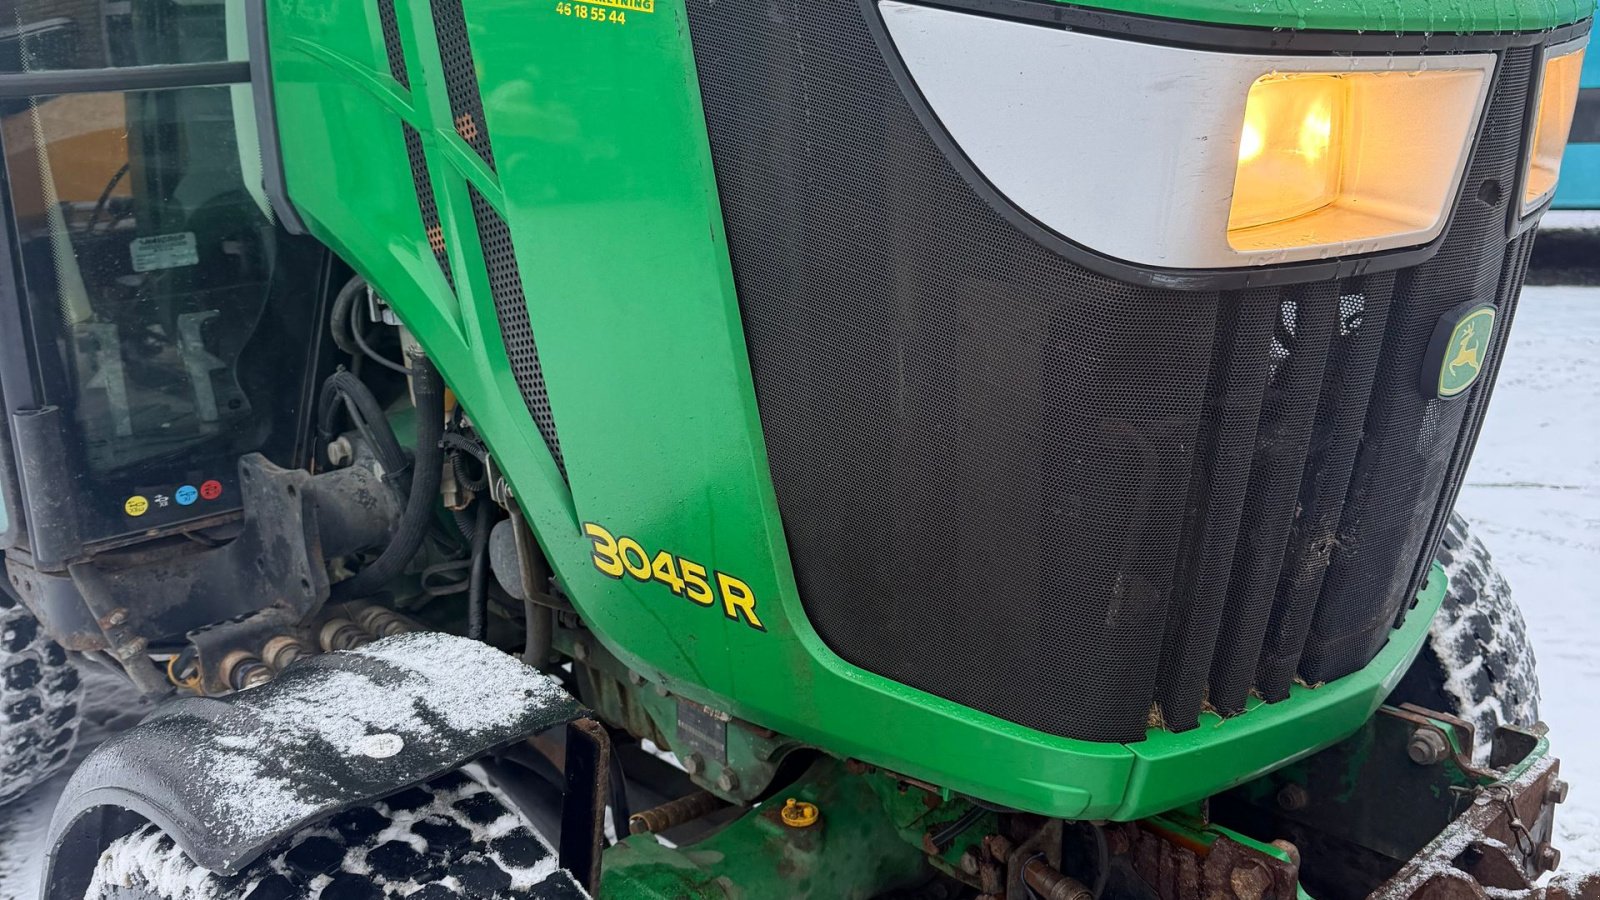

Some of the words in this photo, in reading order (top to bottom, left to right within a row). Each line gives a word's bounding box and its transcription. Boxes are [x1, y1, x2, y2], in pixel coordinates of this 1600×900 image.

[574, 5, 588, 19] 18
[590, 7, 606, 21] 55
[608, 10, 626, 24] 44
[584, 522, 715, 607] 3045
[714, 570, 767, 633] R
